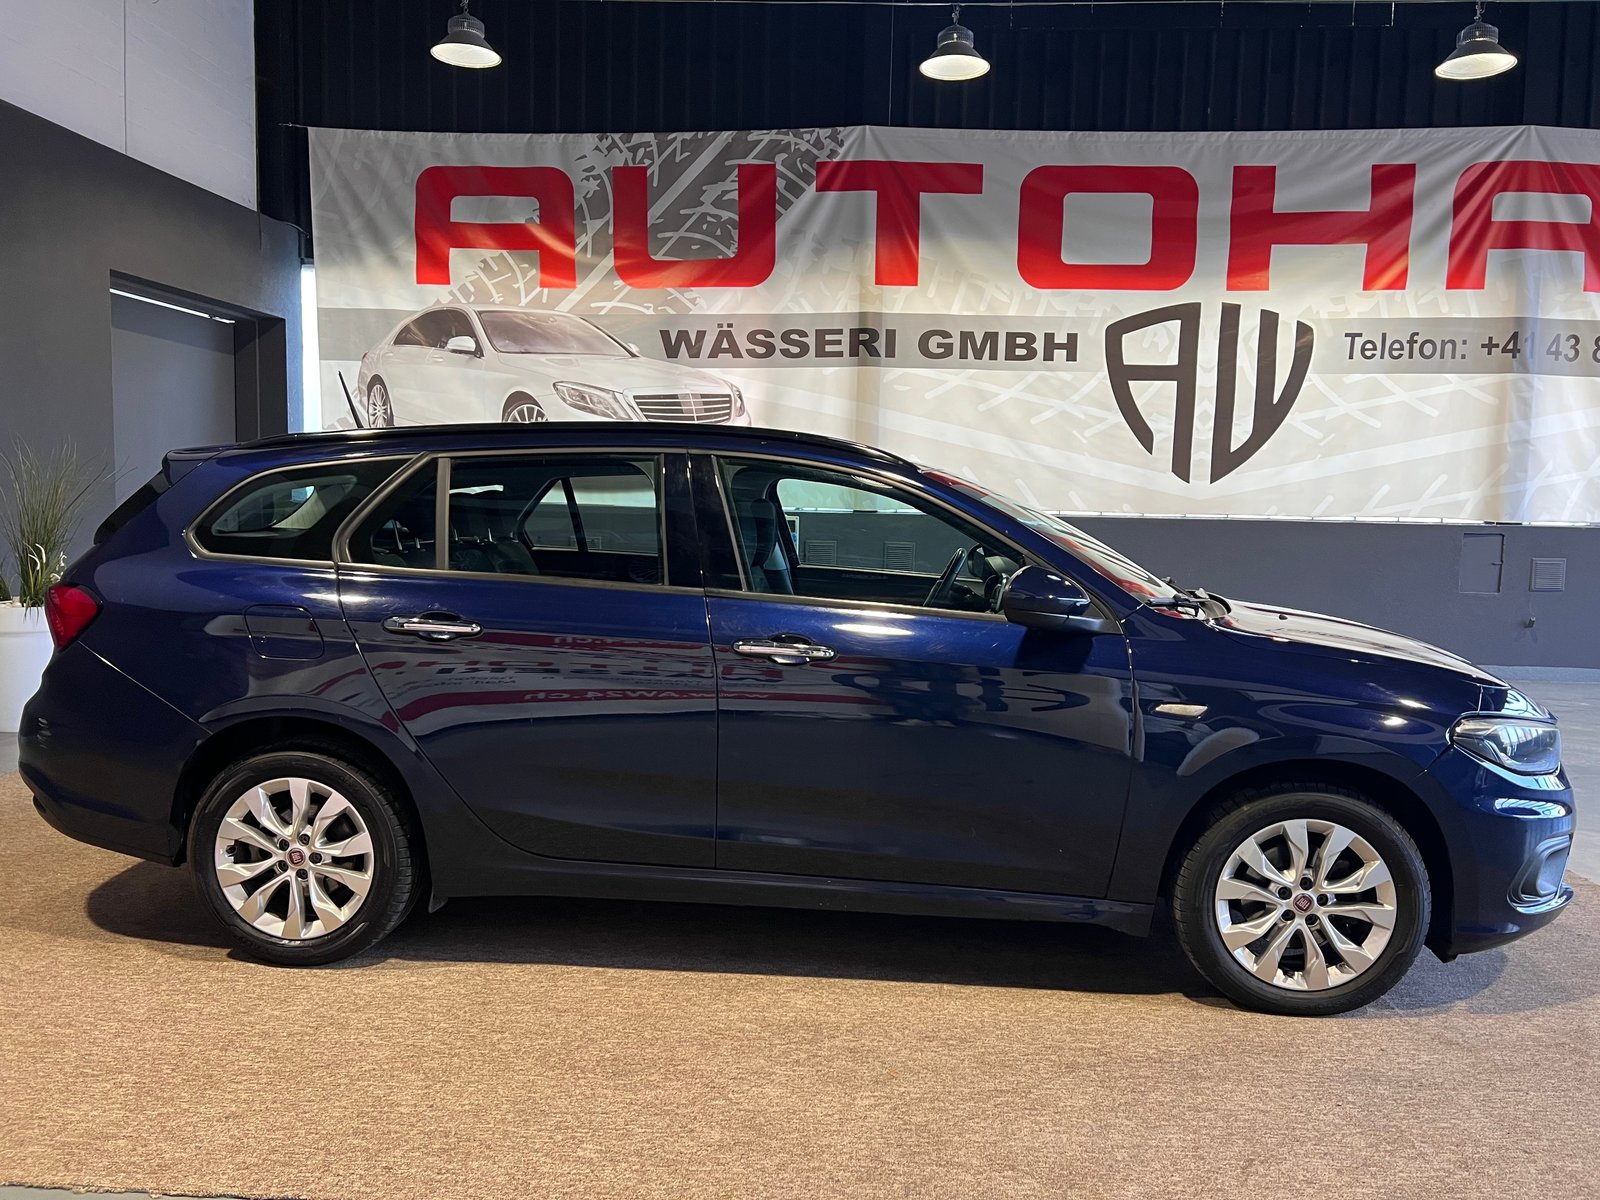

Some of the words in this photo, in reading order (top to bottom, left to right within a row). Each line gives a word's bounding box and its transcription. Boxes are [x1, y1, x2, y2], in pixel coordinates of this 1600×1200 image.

[659, 322, 897, 360] WÄSSERI
[918, 329, 1078, 362] GMBH
[1344, 332, 1468, 361] Telefon:
[1545, 333, 1582, 363] 43
